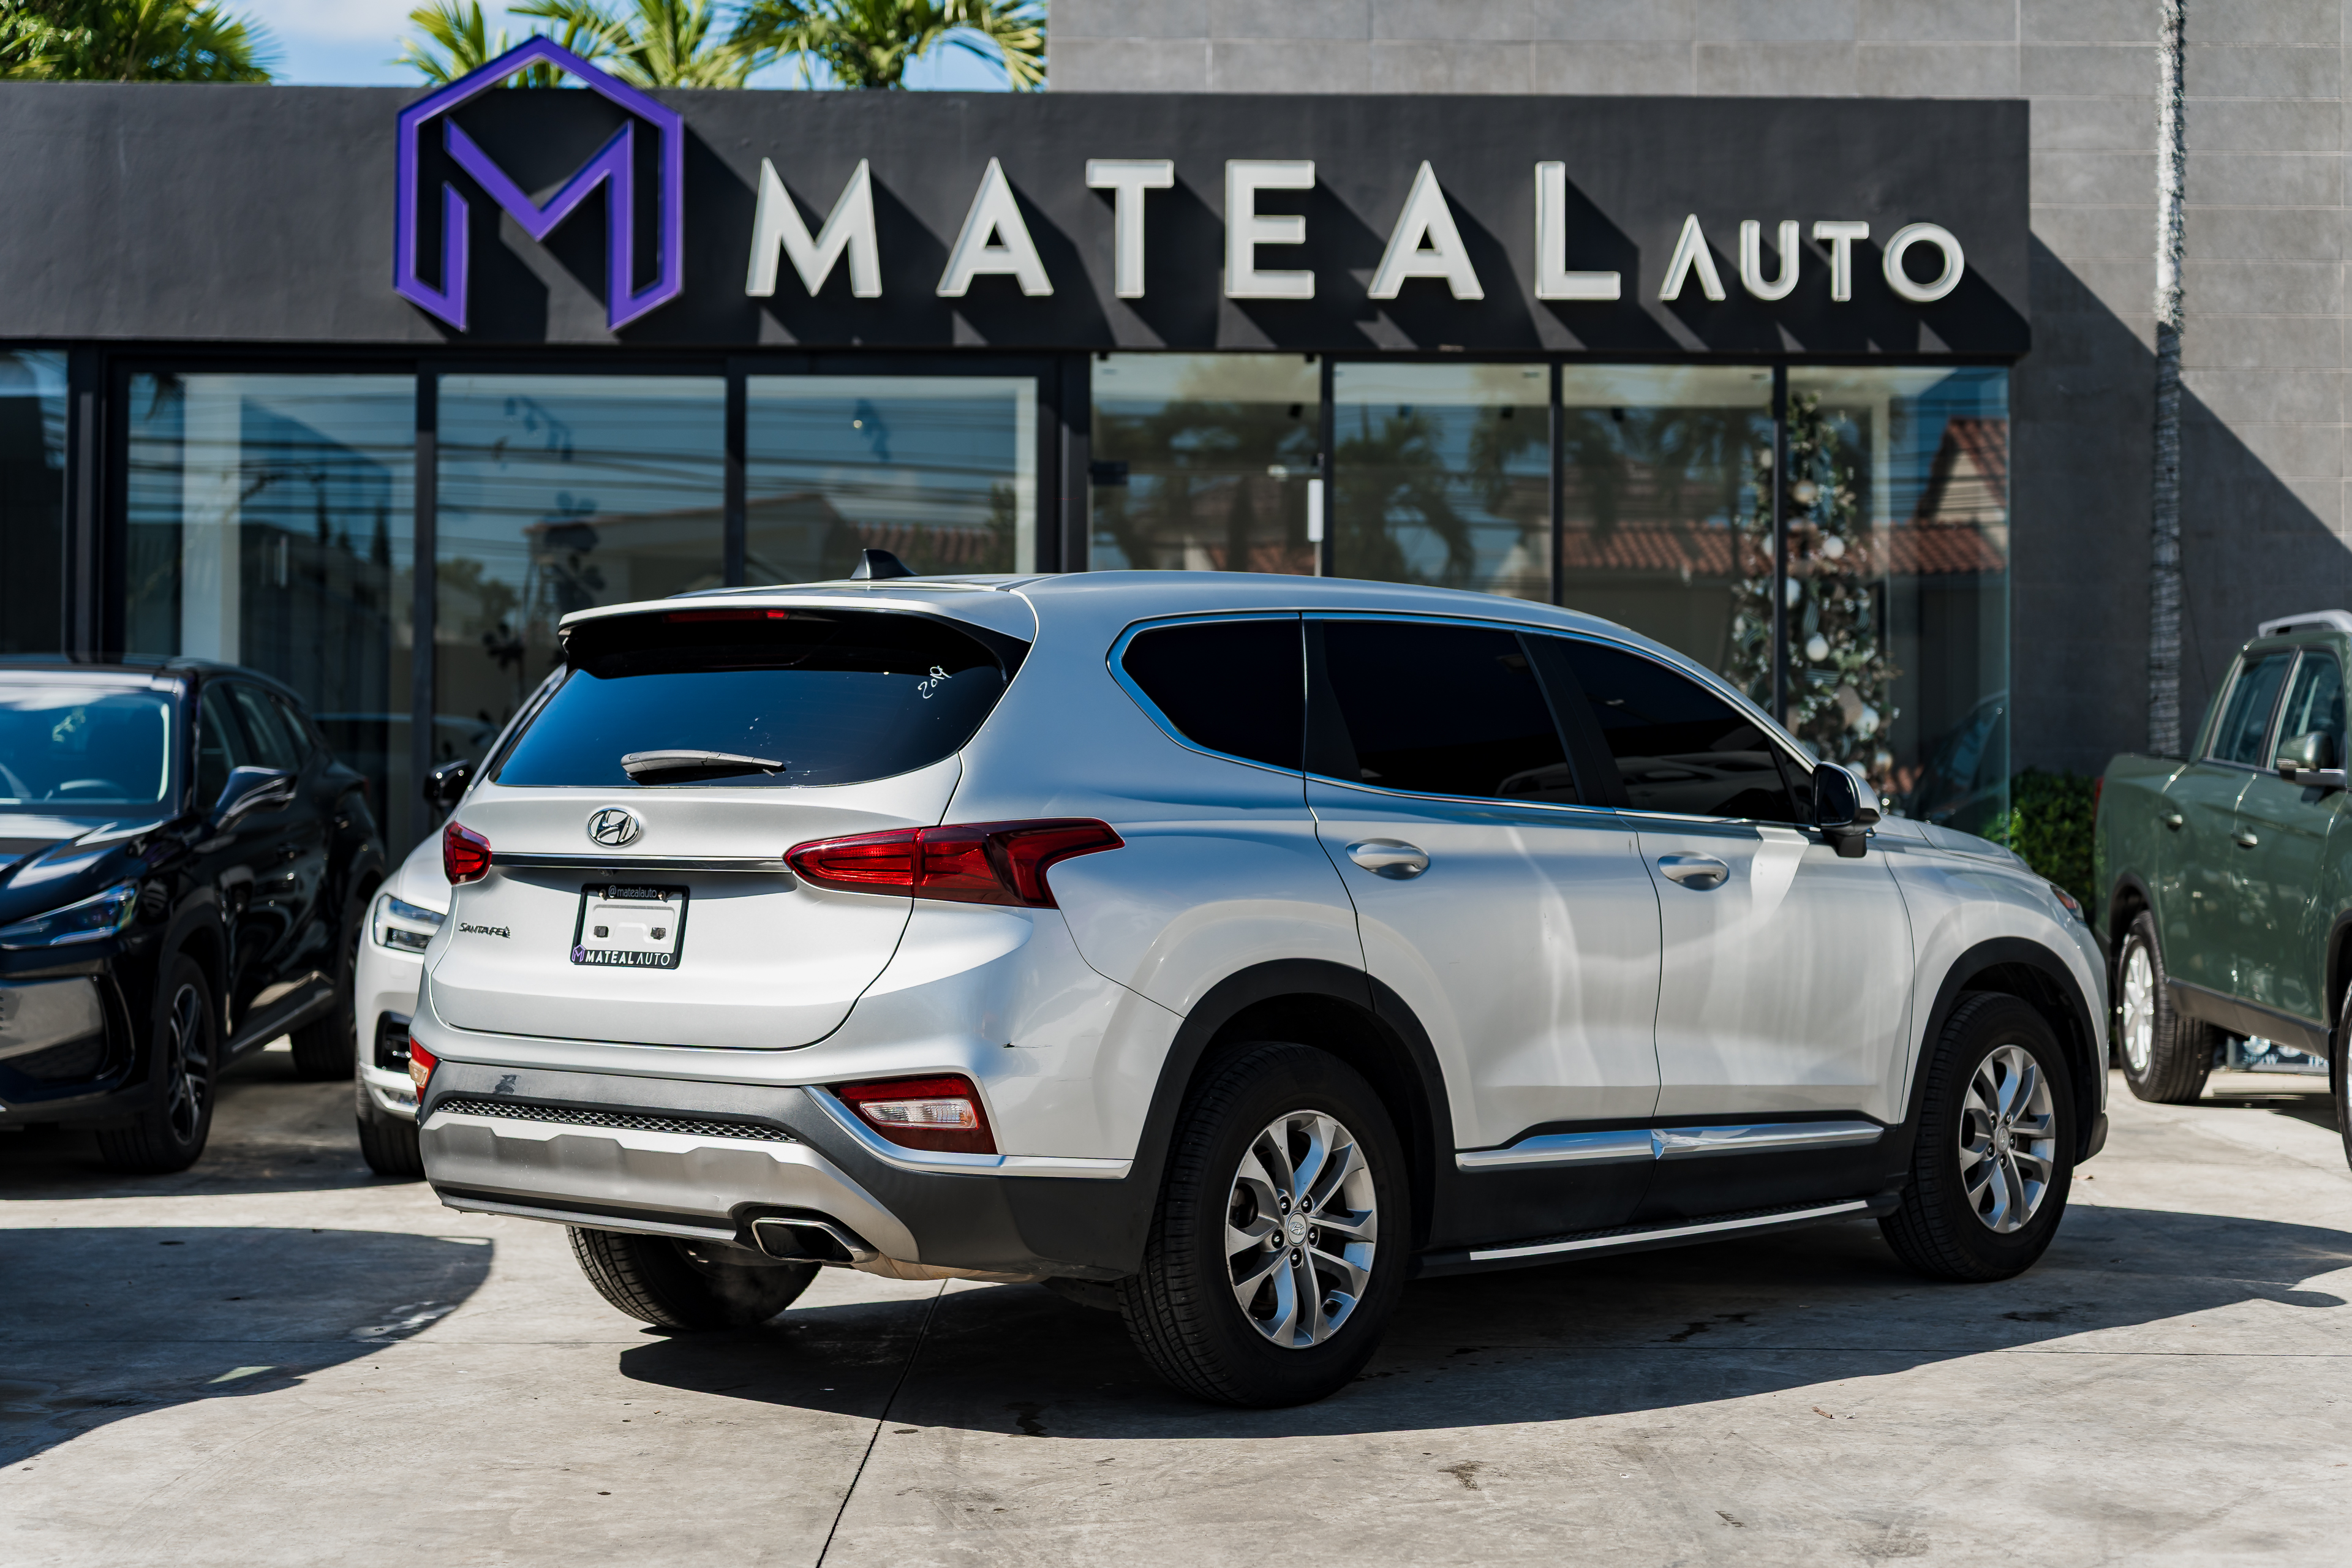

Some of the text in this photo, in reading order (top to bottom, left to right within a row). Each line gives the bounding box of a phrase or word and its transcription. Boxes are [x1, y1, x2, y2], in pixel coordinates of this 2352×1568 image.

[745, 156, 1965, 303] MATEAL AUTO
[608, 885, 657, 899] @matealauto
[585, 950, 671, 966] MATEAL AUTO
